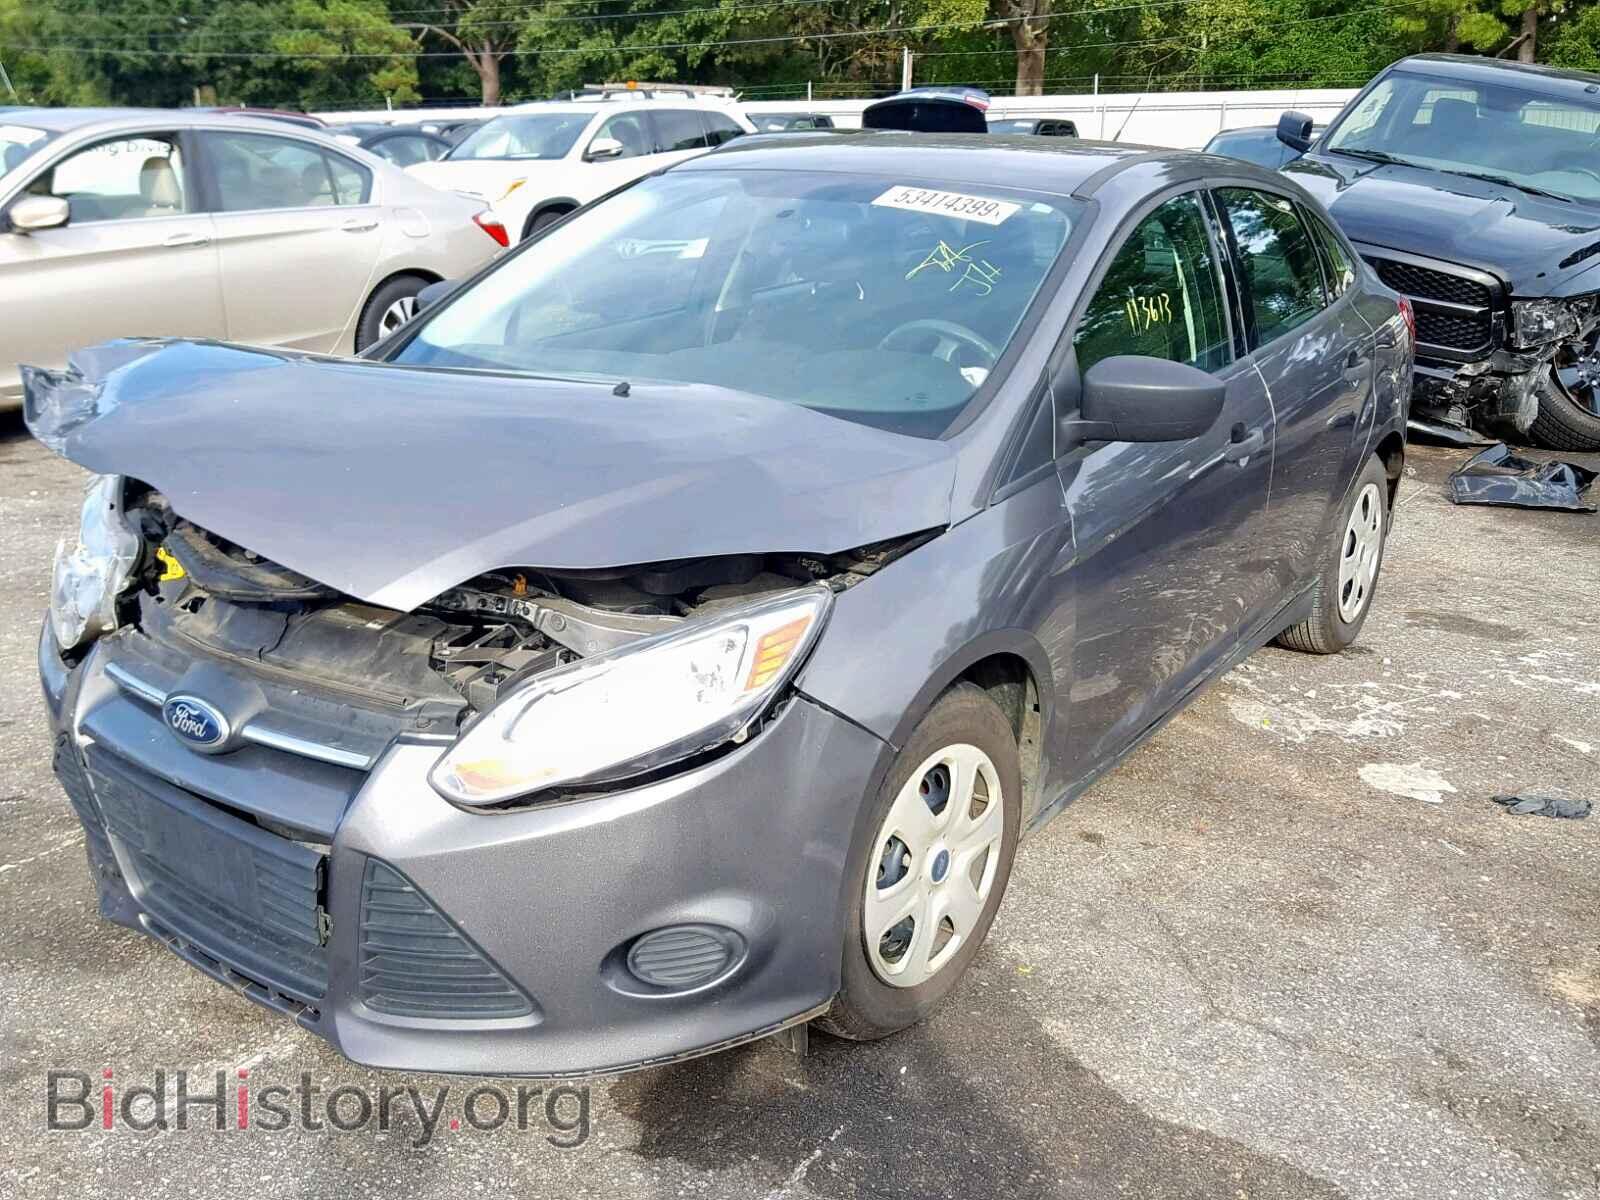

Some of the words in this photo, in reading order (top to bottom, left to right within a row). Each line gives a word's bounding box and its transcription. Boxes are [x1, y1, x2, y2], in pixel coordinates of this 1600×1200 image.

[893, 188, 997, 218] 53414399
[1126, 291, 1172, 337] 113613
[171, 703, 209, 738] Ford
